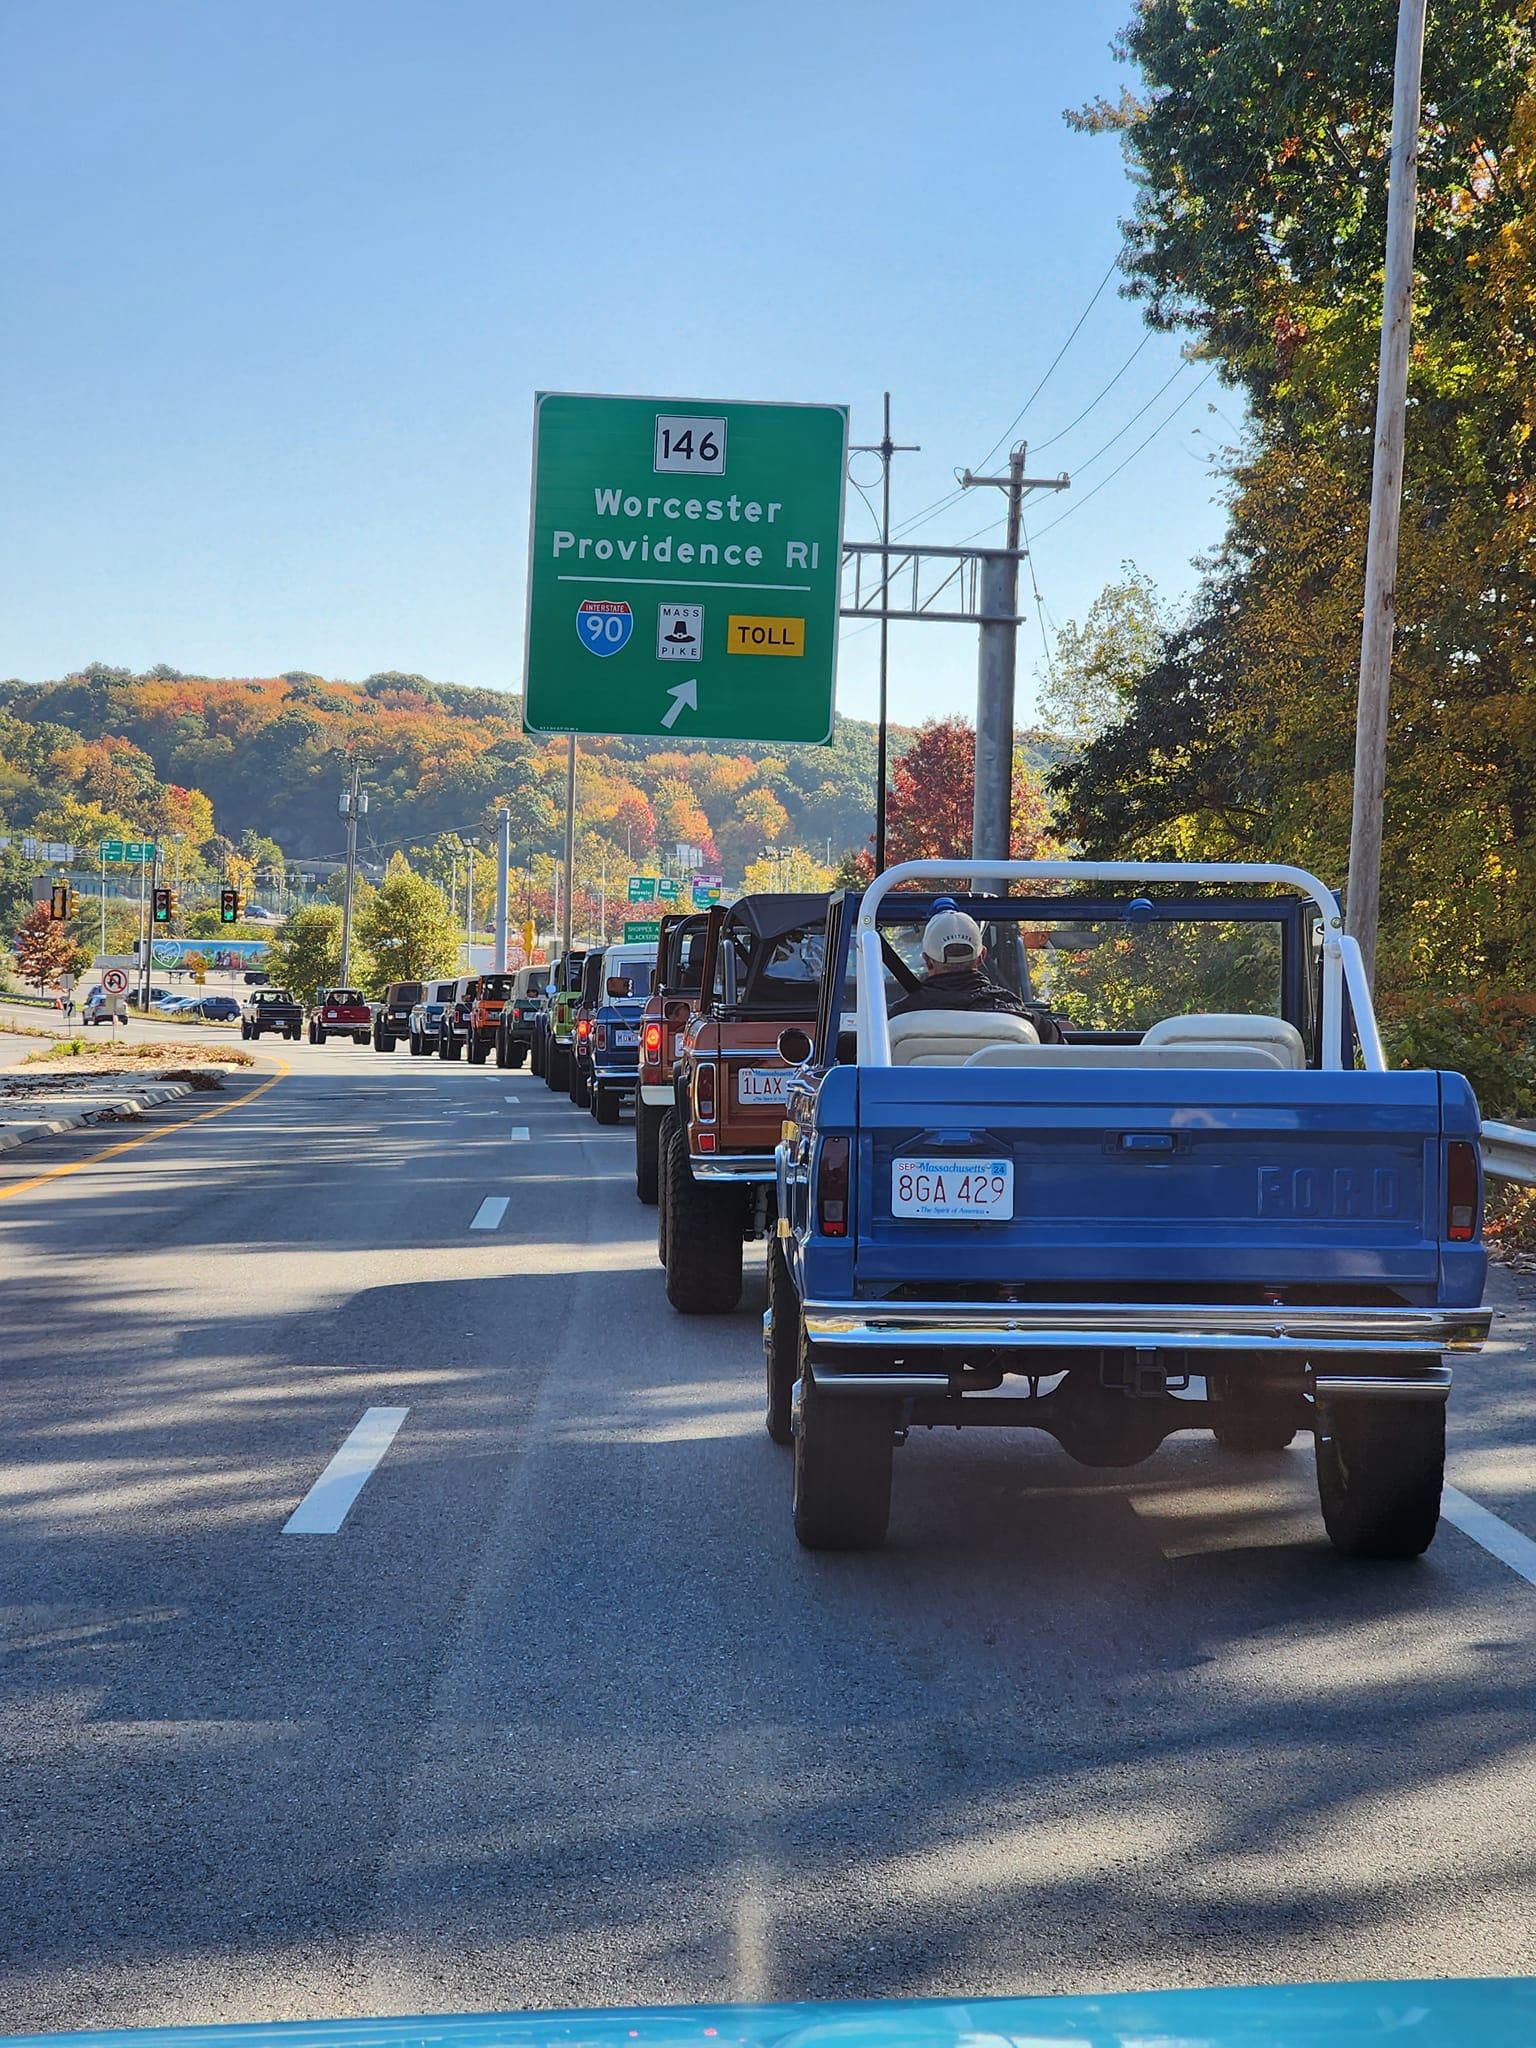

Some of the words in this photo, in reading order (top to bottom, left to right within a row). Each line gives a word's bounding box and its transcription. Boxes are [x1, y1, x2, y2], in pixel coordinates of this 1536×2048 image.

[662, 429, 719, 461] 146
[594, 488, 782, 523] Worcester
[552, 530, 763, 567] Providence
[786, 541, 819, 569] RI
[585, 603, 625, 613] INTERSTATE
[663, 608, 700, 617] MASS
[586, 615, 623, 642] 90
[738, 626, 795, 645] TOLL
[661, 647, 697, 656] PIKE
[743, 1077, 782, 1095] 1LAX
[899, 1163, 915, 1171] SEP
[919, 1162, 986, 1173] Massachusetts
[993, 1166, 1005, 1174] 24
[899, 1175, 947, 1203] 8GA
[957, 1175, 1005, 1204] 429
[1258, 1166, 1400, 1216] FORD
